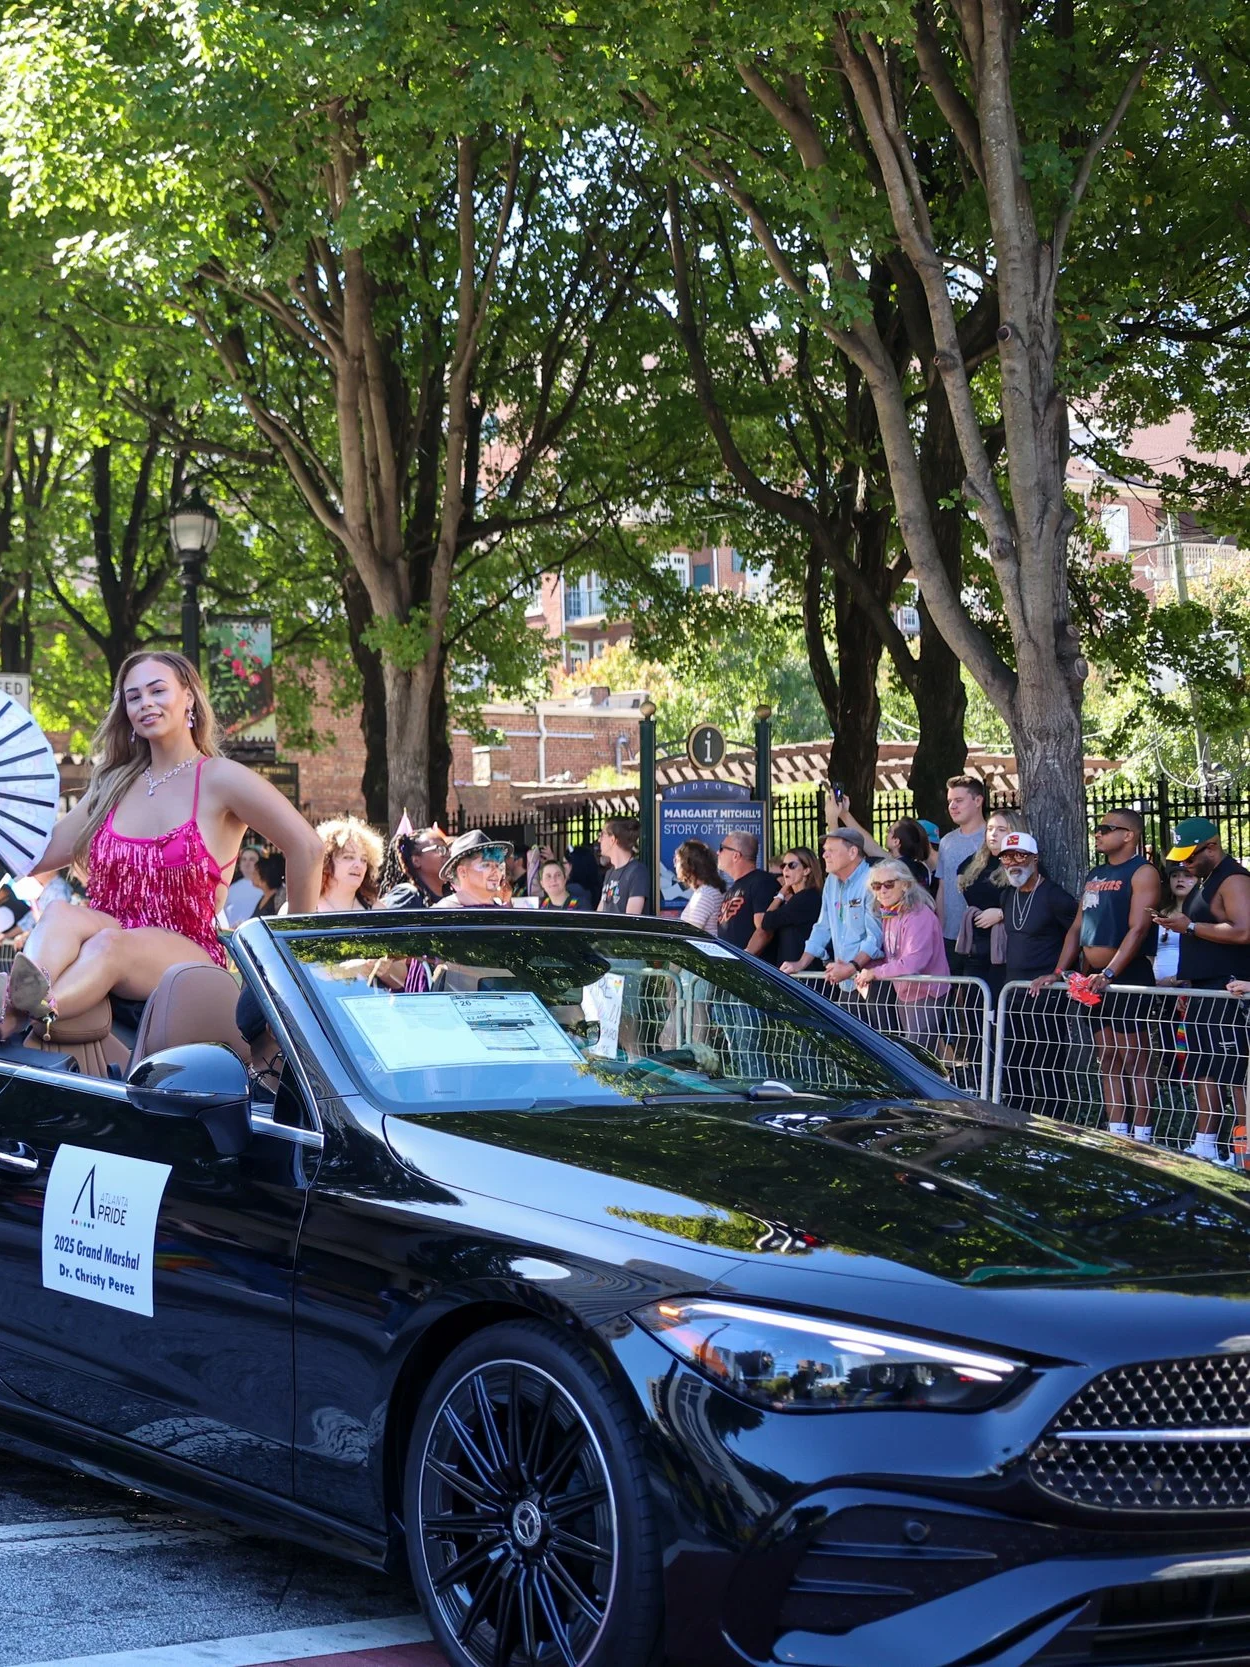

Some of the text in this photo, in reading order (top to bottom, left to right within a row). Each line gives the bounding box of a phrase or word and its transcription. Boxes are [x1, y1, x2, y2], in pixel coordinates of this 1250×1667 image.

[670, 783, 746, 796] MIDTOWN
[664, 809, 761, 819] MARGARET MITCHELL'S
[664, 824, 698, 835] STORY
[700, 824, 712, 835] OF
[715, 824, 733, 835] THE
[100, 1193, 129, 1208] ATLANTA
[97, 1204, 127, 1226] PRIDE
[54, 1234, 141, 1271] 2025 Grand Marshal
[59, 1263, 135, 1296] Dr. Christy Perez
